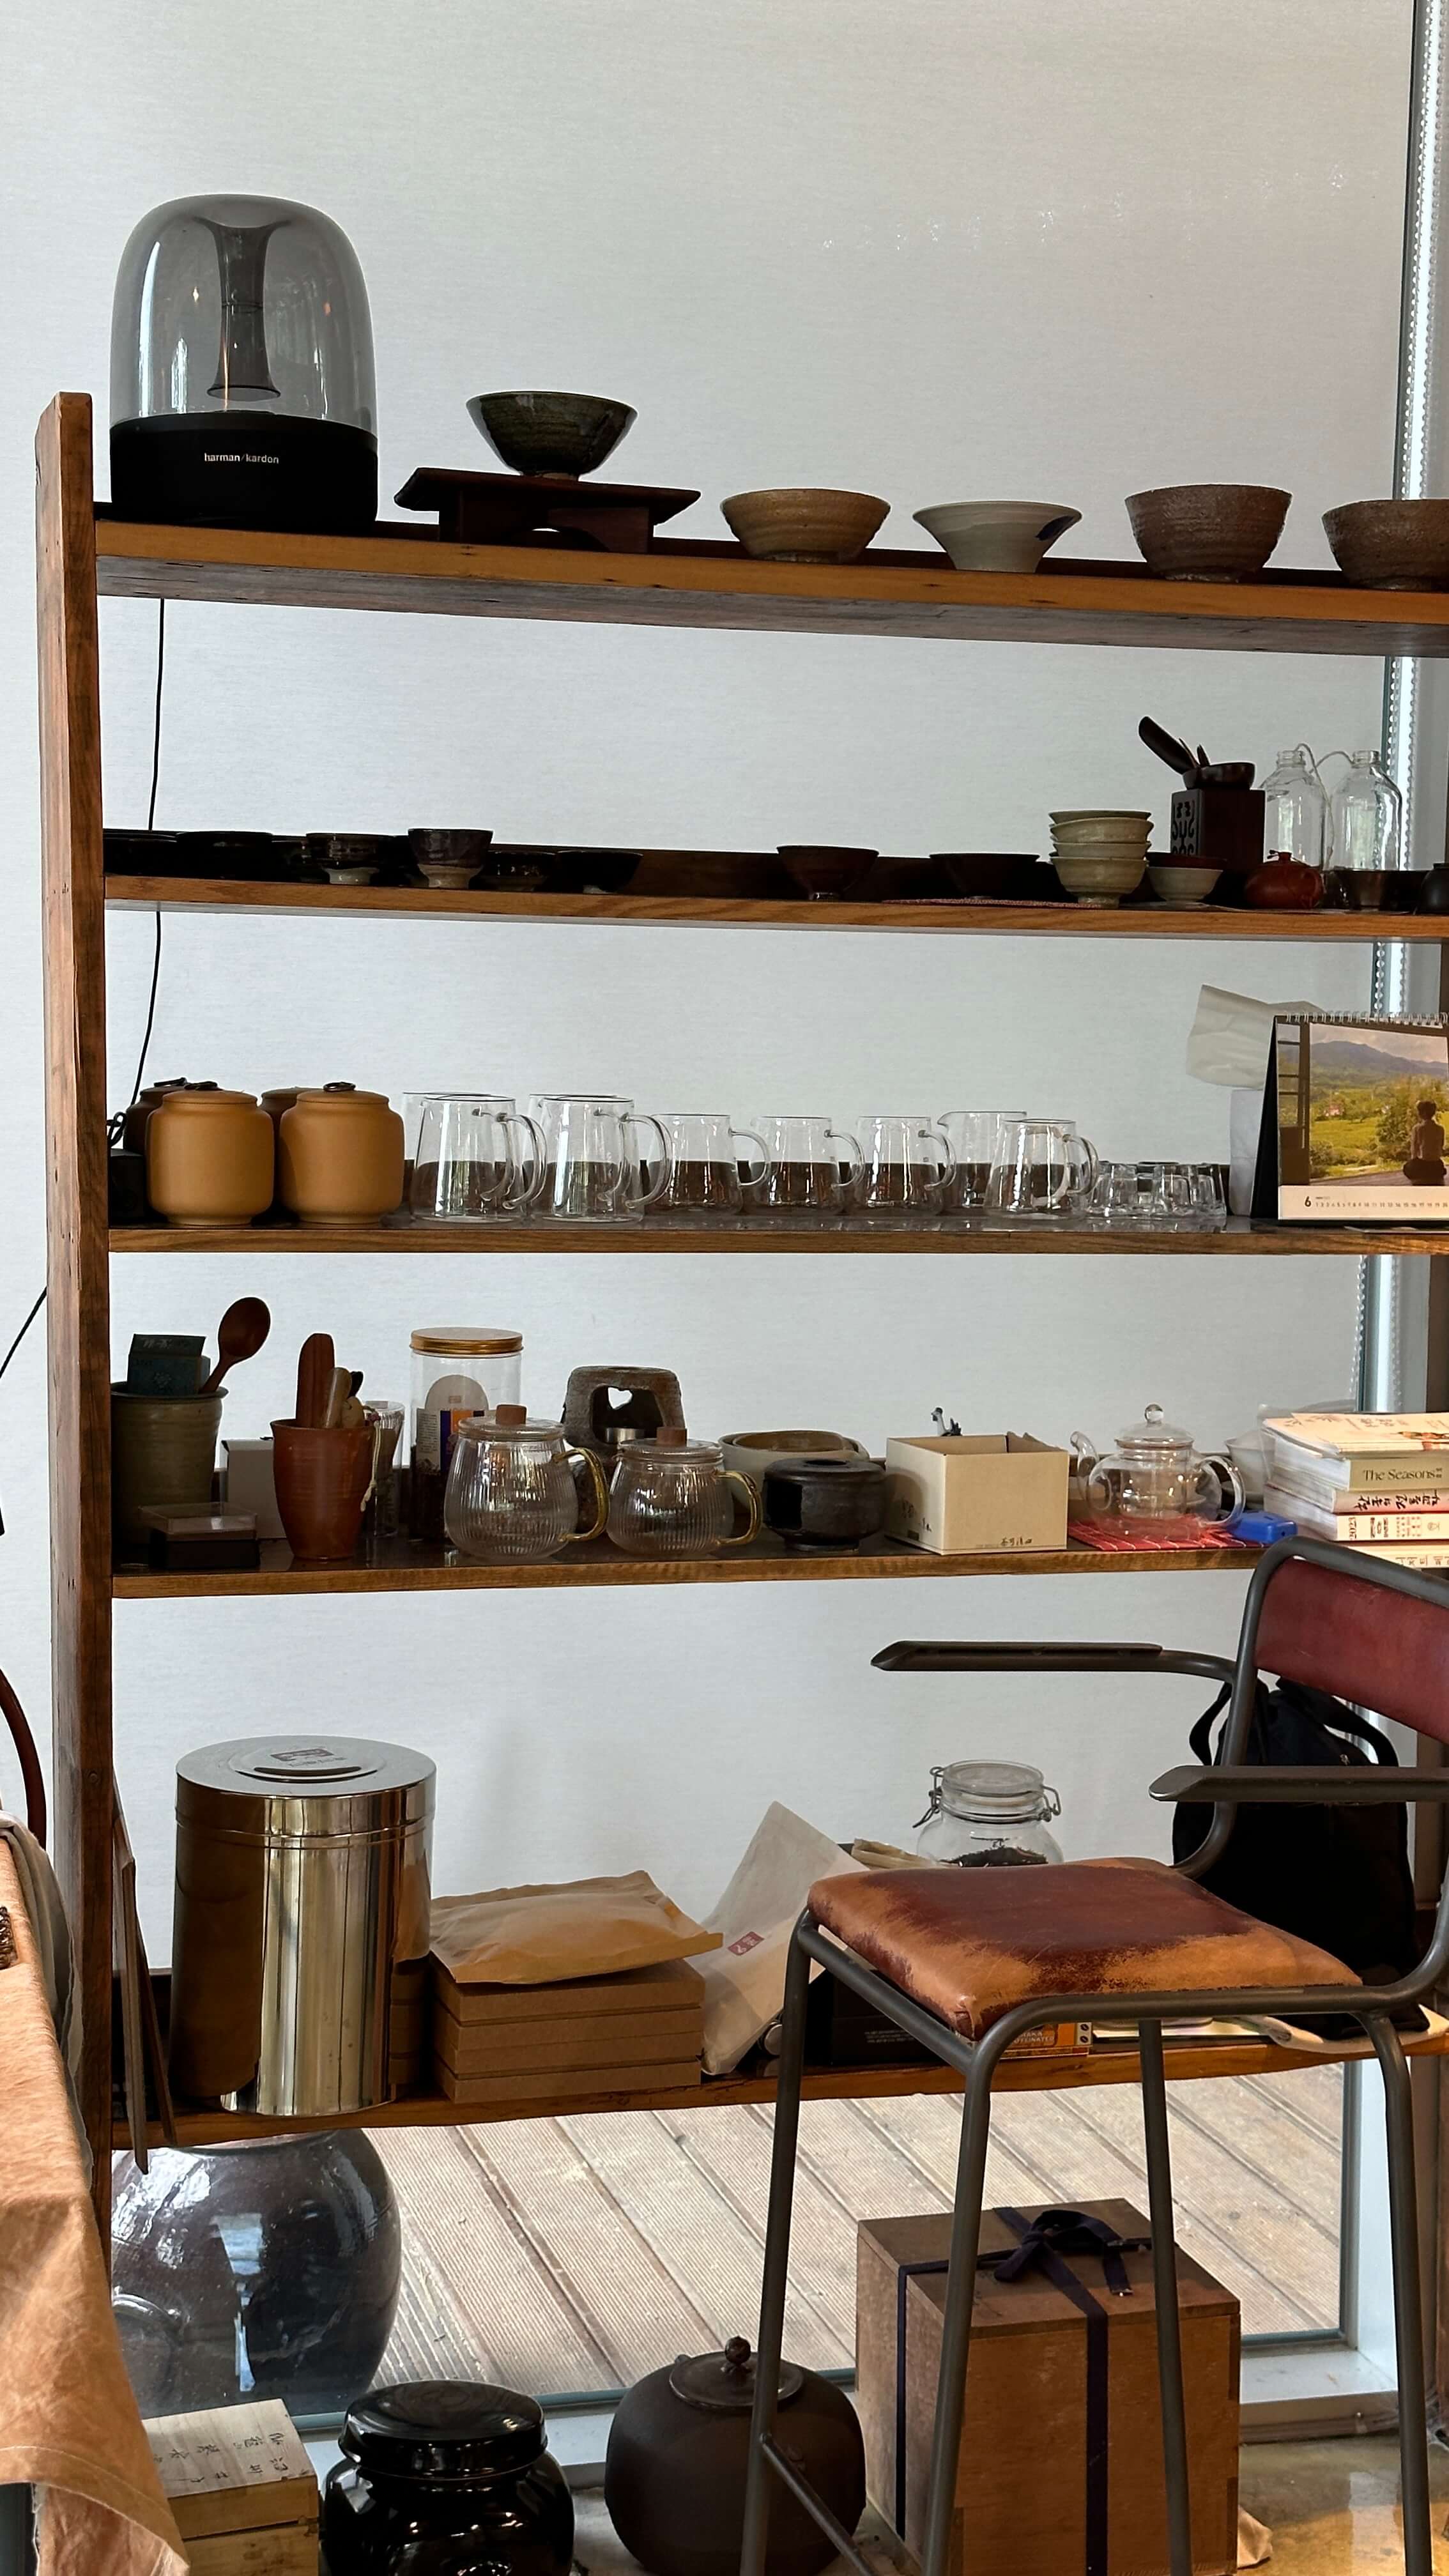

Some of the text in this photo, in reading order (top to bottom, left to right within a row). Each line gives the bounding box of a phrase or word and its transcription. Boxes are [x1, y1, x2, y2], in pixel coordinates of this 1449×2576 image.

[1305, 1195, 1312, 1208] 6
[1363, 1469, 1385, 1482] The
[1387, 1468, 1436, 1481] Seasons
